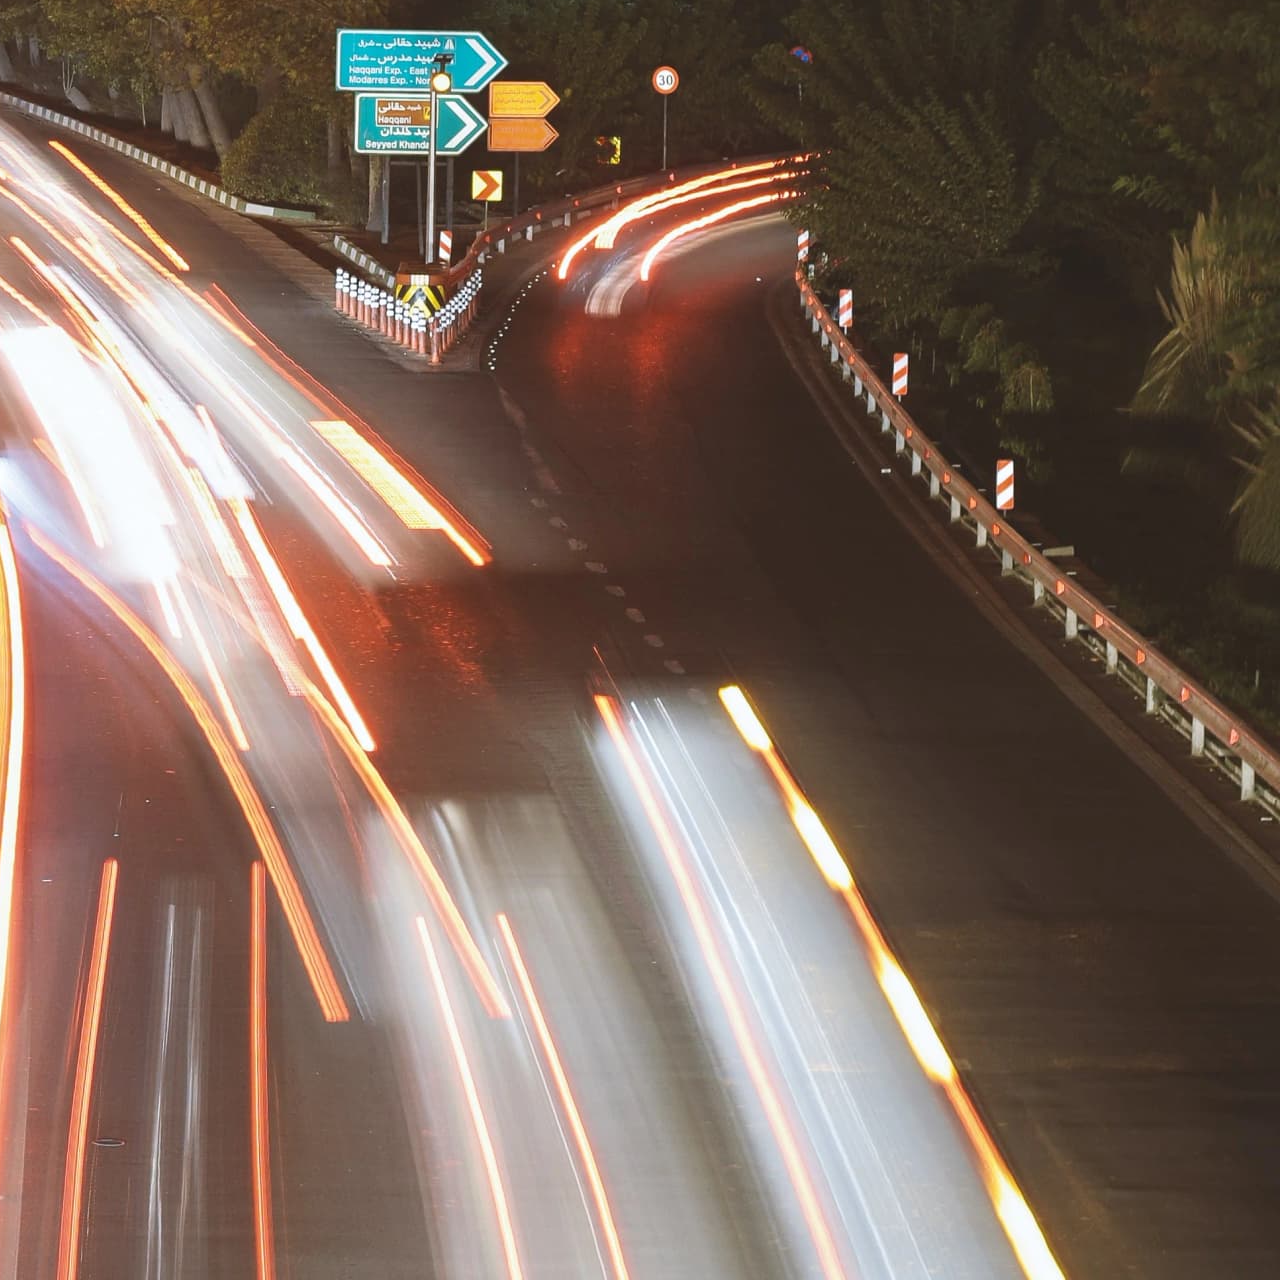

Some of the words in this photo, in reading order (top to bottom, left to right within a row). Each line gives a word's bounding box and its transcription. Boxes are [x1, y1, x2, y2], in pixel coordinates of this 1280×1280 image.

[382, 37, 413, 49] حقانی
[414, 37, 441, 49] شهید
[377, 53, 412, 65] مدرس
[348, 65, 382, 75] Haqqani
[384, 66, 402, 76] Exp.
[409, 66, 428, 75] East
[348, 75, 389, 85] Modarres
[390, 76, 408, 86] Exp.
[415, 76, 431, 86] Nor
[658, 74, 673, 86] 30
[378, 101, 406, 113] حقانی
[378, 115, 411, 125] Haqqani
